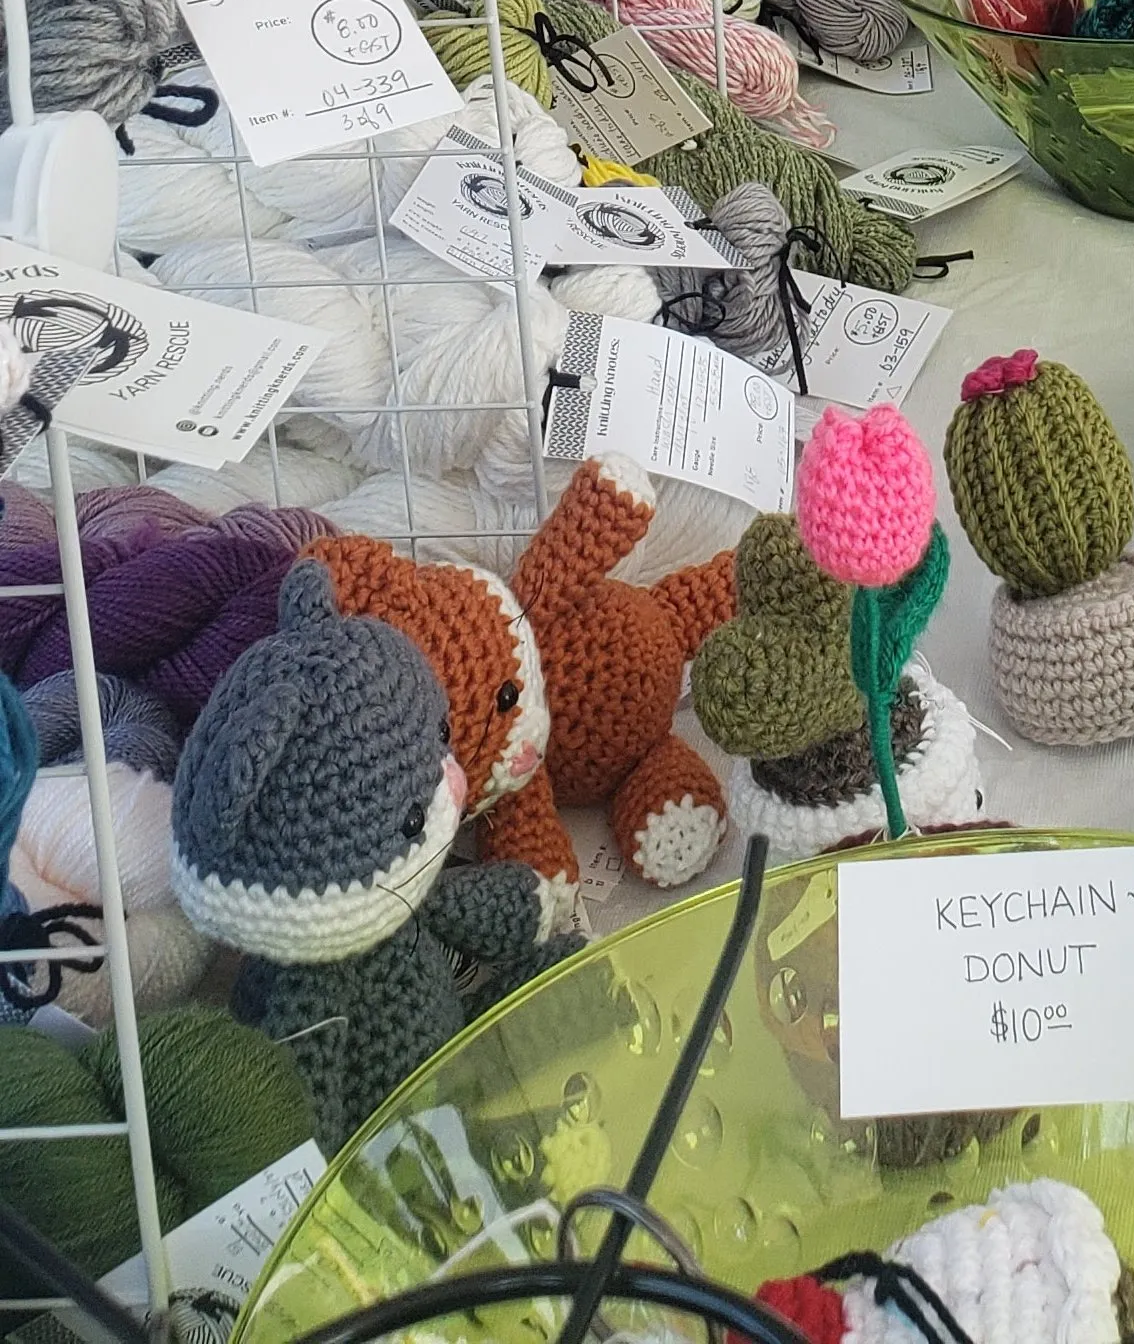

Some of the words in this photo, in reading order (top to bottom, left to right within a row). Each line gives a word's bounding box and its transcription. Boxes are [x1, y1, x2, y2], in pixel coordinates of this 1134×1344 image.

[254, 15, 293, 31] Price:
[321, 69, 411, 107] 04-339
[248, 113, 279, 127] Item
[479, 215, 511, 231] RESC
[108, 368, 167, 402] YARN
[160, 319, 190, 372] RESCUE
[604, 337, 621, 387] Knotes:
[231, 344, 309, 442] www.knittingknerds.com
[596, 388, 616, 438] Knitting
[934, 879, 1118, 930] KEYCHAIN
[964, 944, 1097, 984] DONUT
